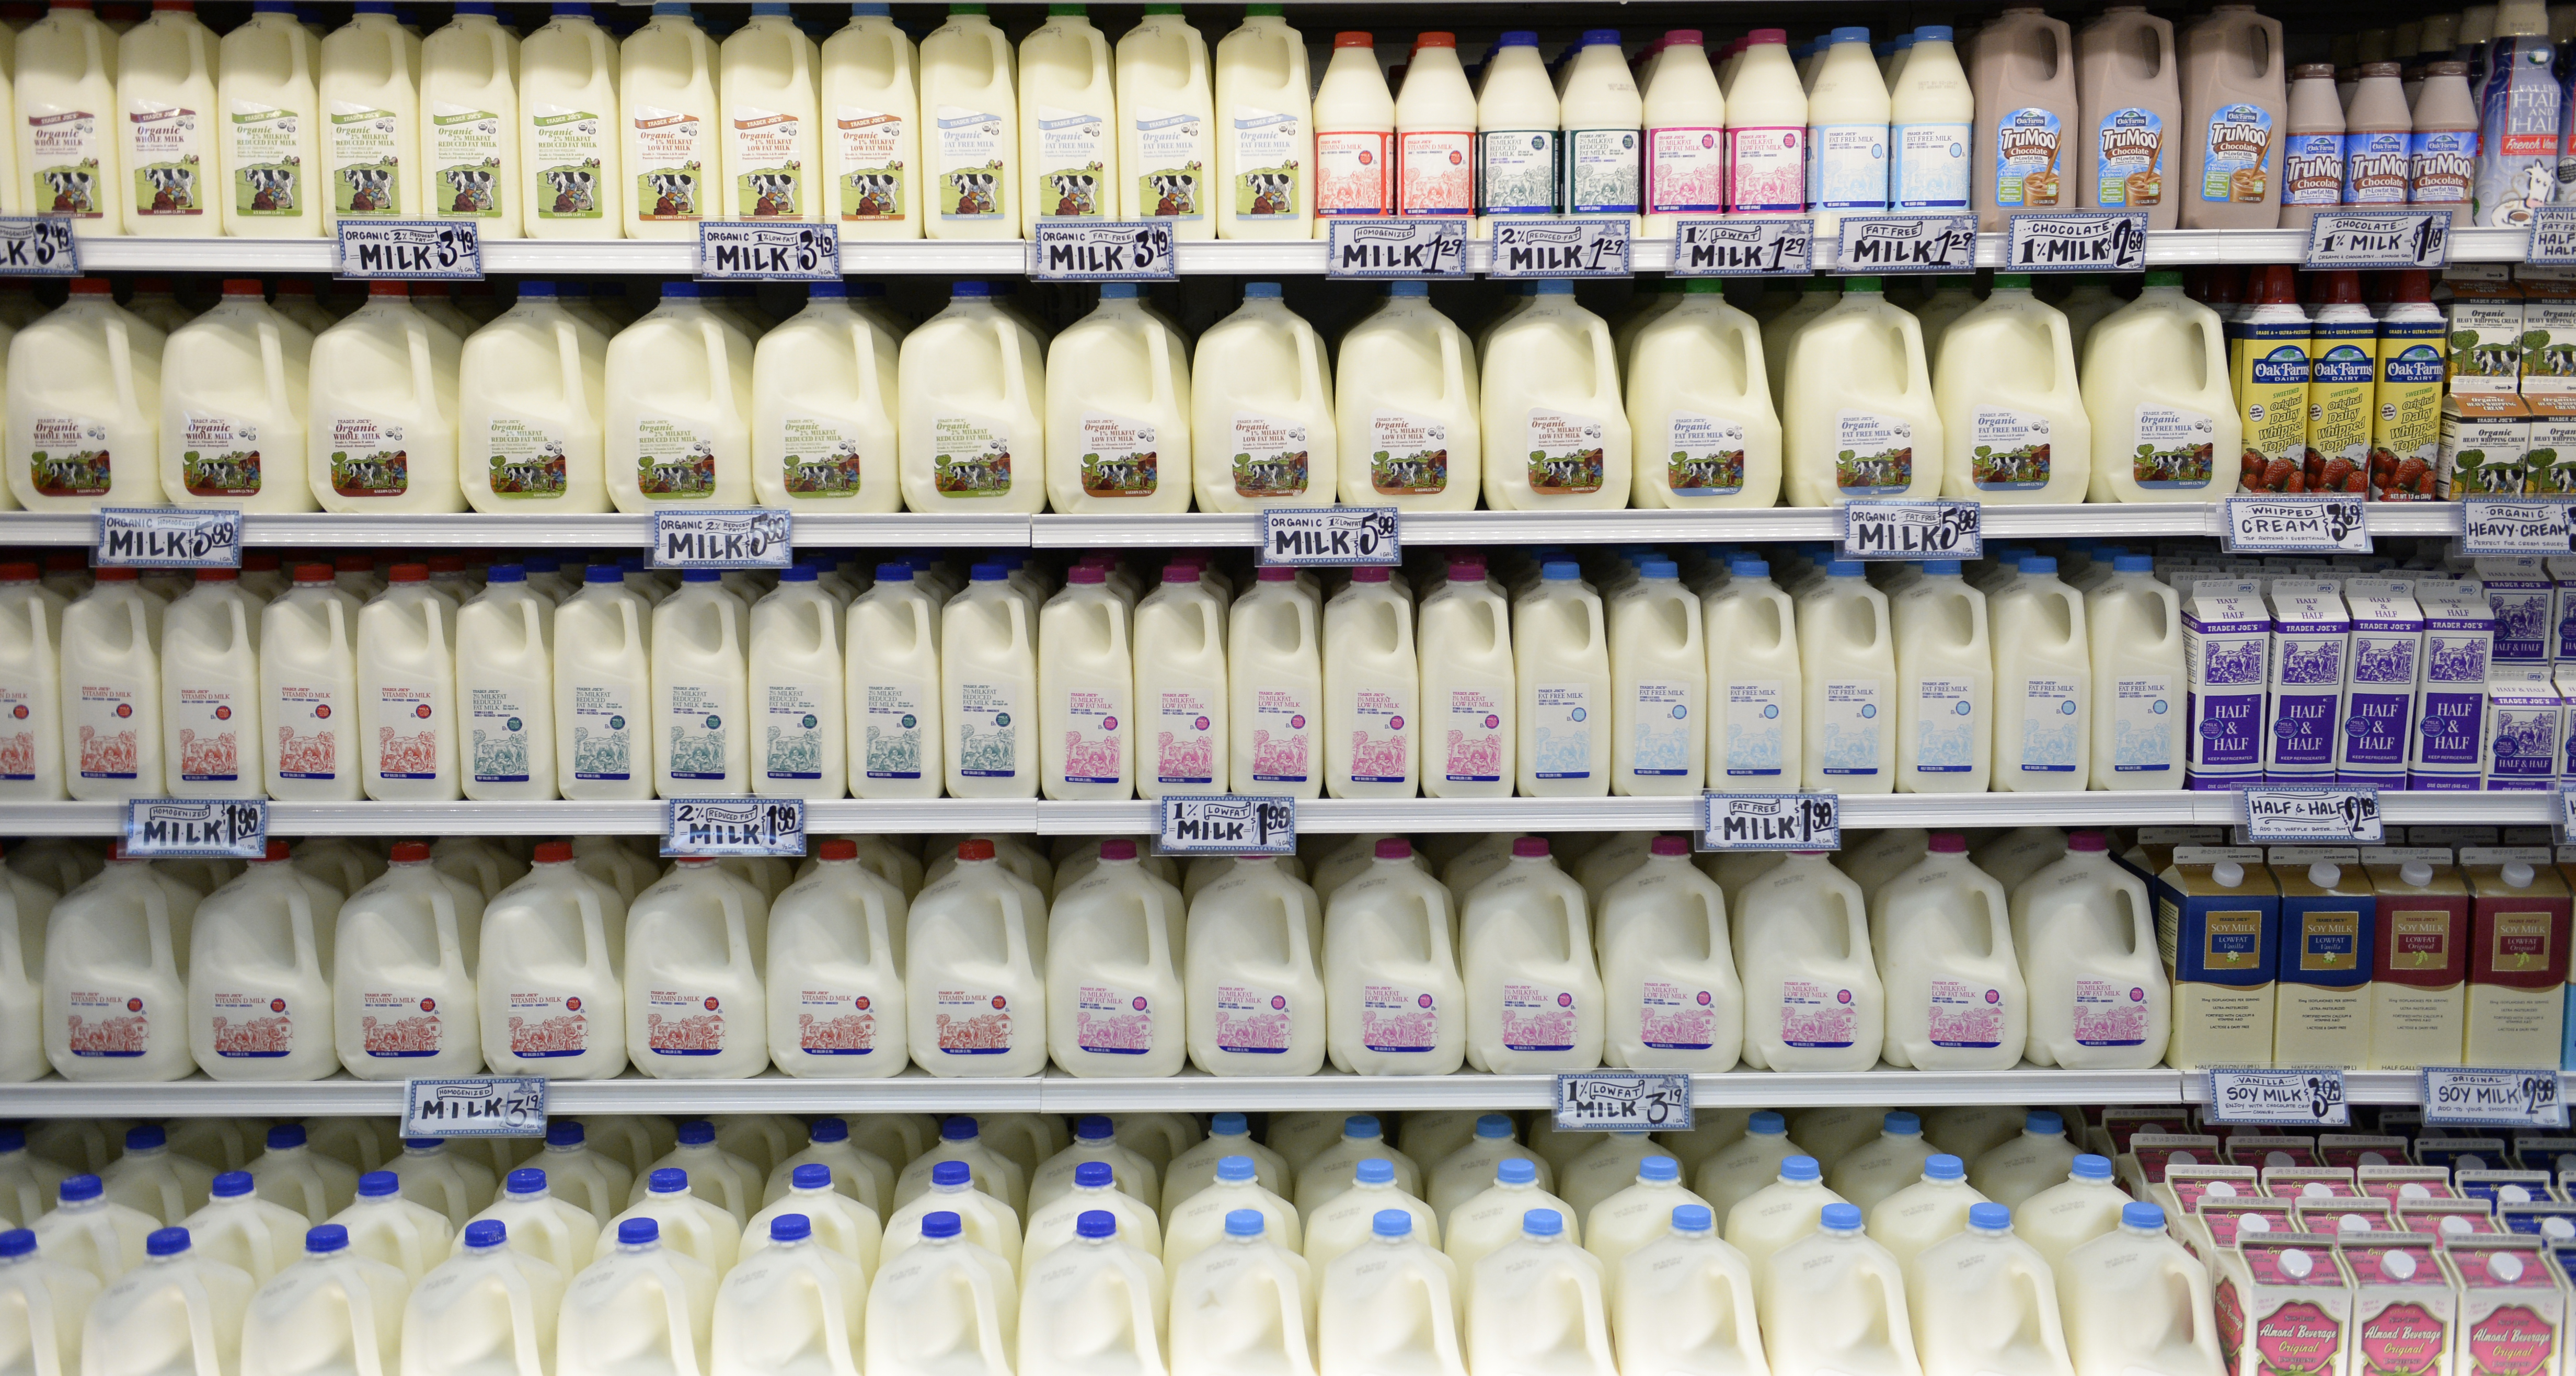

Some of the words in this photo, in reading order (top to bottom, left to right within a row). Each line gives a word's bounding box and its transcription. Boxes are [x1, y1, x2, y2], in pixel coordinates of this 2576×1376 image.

[137, 127, 180, 138] Organic
[640, 132, 675, 142] Organic
[2002, 129, 2056, 149] TruMoo
[2506, 138, 2540, 150] French
[2288, 156, 2342, 179] TruMoo
[2297, 178, 2338, 188] Chocolate
[2032, 222, 2109, 235] CHOCOLATE
[2336, 220, 2397, 231] CHOCOLATE
[346, 232, 390, 241] ORGANIC
[394, 232, 407, 240] 2%
[707, 233, 749, 241] ORGANIC
[1357, 229, 1412, 237] HOMOGENIZED
[1684, 226, 1707, 243] 1%
[1715, 231, 1756, 240] LOWFAT
[2320, 234, 2345, 253] 1%
[2350, 233, 2402, 250] MILK
[2538, 234, 2575, 245] HALF
[2019, 238, 2046, 263] 1%
[2048, 238, 2108, 261] MILK
[2471, 310, 2505, 319] Organic
[2339, 362, 2372, 376] Farms
[2330, 387, 2359, 398] SWEETENED
[2327, 394, 2362, 411] Original
[1978, 417, 2017, 427] Organic
[2327, 408, 2359, 425] Dairy
[491, 423, 525, 432] Organic
[2317, 420, 2365, 441] Whipped
[2321, 433, 2364, 453] Topping
[2252, 507, 2313, 517] WHIPPED
[2490, 508, 2544, 517] ORGANIC
[107, 517, 152, 528] ORGANIC
[661, 521, 702, 531] ORGANIC
[706, 522, 720, 531] 2%
[1271, 518, 1322, 527] ORGANIC
[2215, 705, 2249, 718] HALF
[2226, 722, 2237, 734] &
[2213, 738, 2249, 751] HALF
[676, 805, 705, 821] 2%
[709, 810, 738, 820] REDUCED
[1172, 802, 1198, 820] 1%
[1208, 806, 1247, 817] LOWFAT
[1732, 803, 1750, 812] FAT
[1752, 802, 1776, 812] FREE
[2251, 800, 2292, 815] HALF
[2296, 803, 2305, 811] &
[2309, 800, 2344, 815] HALF
[2419, 924, 2444, 932] MILK
[2239, 1077, 2285, 1085] VANILLA
[439, 1088, 490, 1097] HOMOGENIZED
[1567, 1081, 1589, 1102] 1%
[1594, 1085, 1640, 1098] LOWFAT
[2227, 1087, 2258, 1102] SOY
[2263, 1087, 2301, 1101] MILK
[2439, 1086, 2470, 1103] SOY
[2477, 1087, 2517, 1104] MILK
[2260, 1324, 2294, 1338] Almond
[2296, 1325, 2337, 1338] Beverage
[2279, 1341, 2319, 1354] Original
